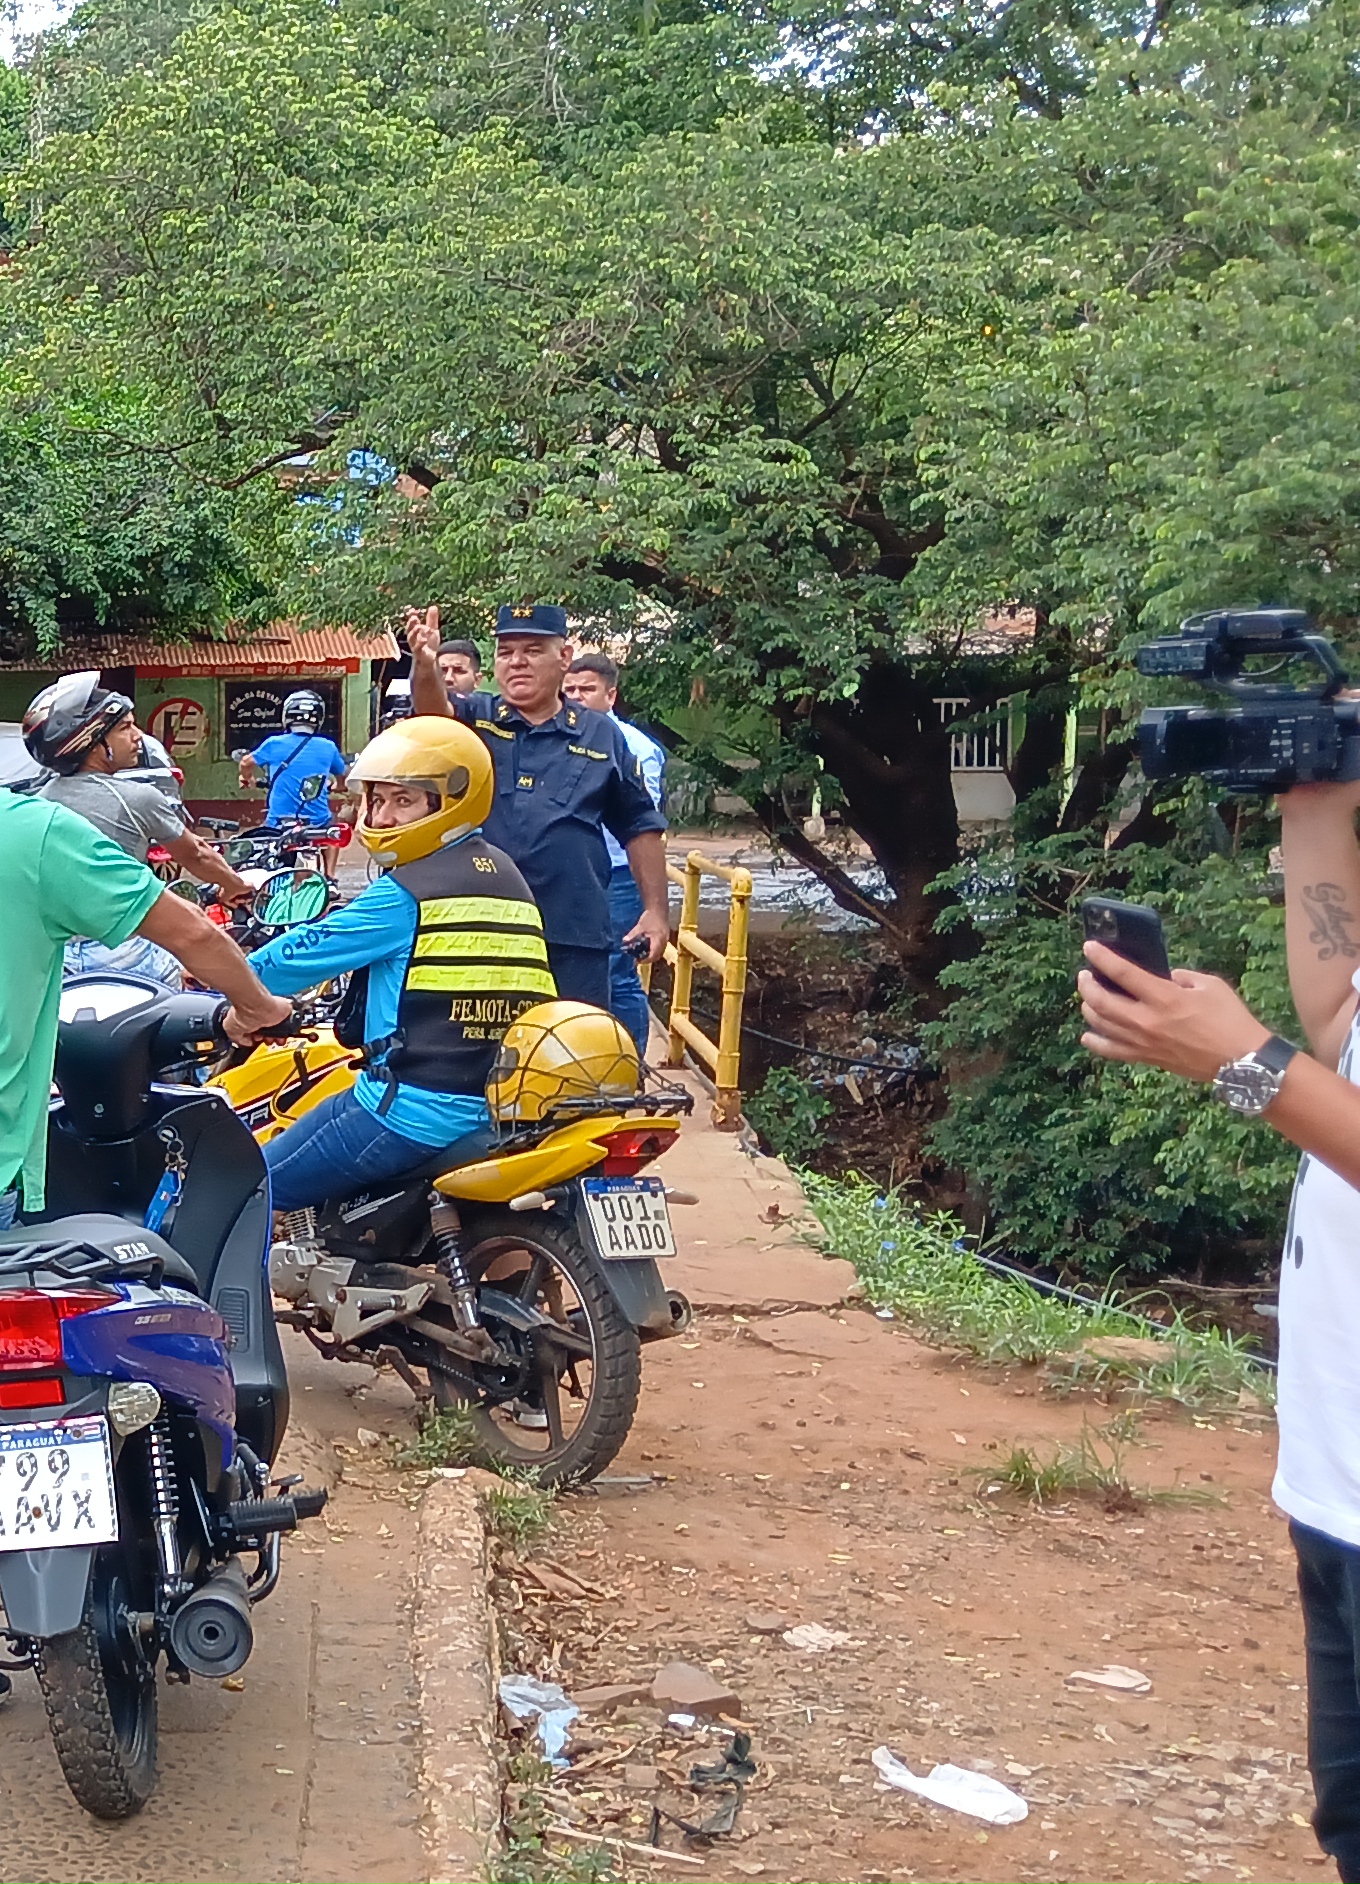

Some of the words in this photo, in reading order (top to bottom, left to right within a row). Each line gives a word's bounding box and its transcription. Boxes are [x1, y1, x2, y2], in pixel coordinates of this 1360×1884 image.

[472, 857, 498, 873] 851
[600, 1194, 651, 1223] 001
[113, 1242, 150, 1260] STAR
[1, 1436, 63, 1450] PARAGUAY
